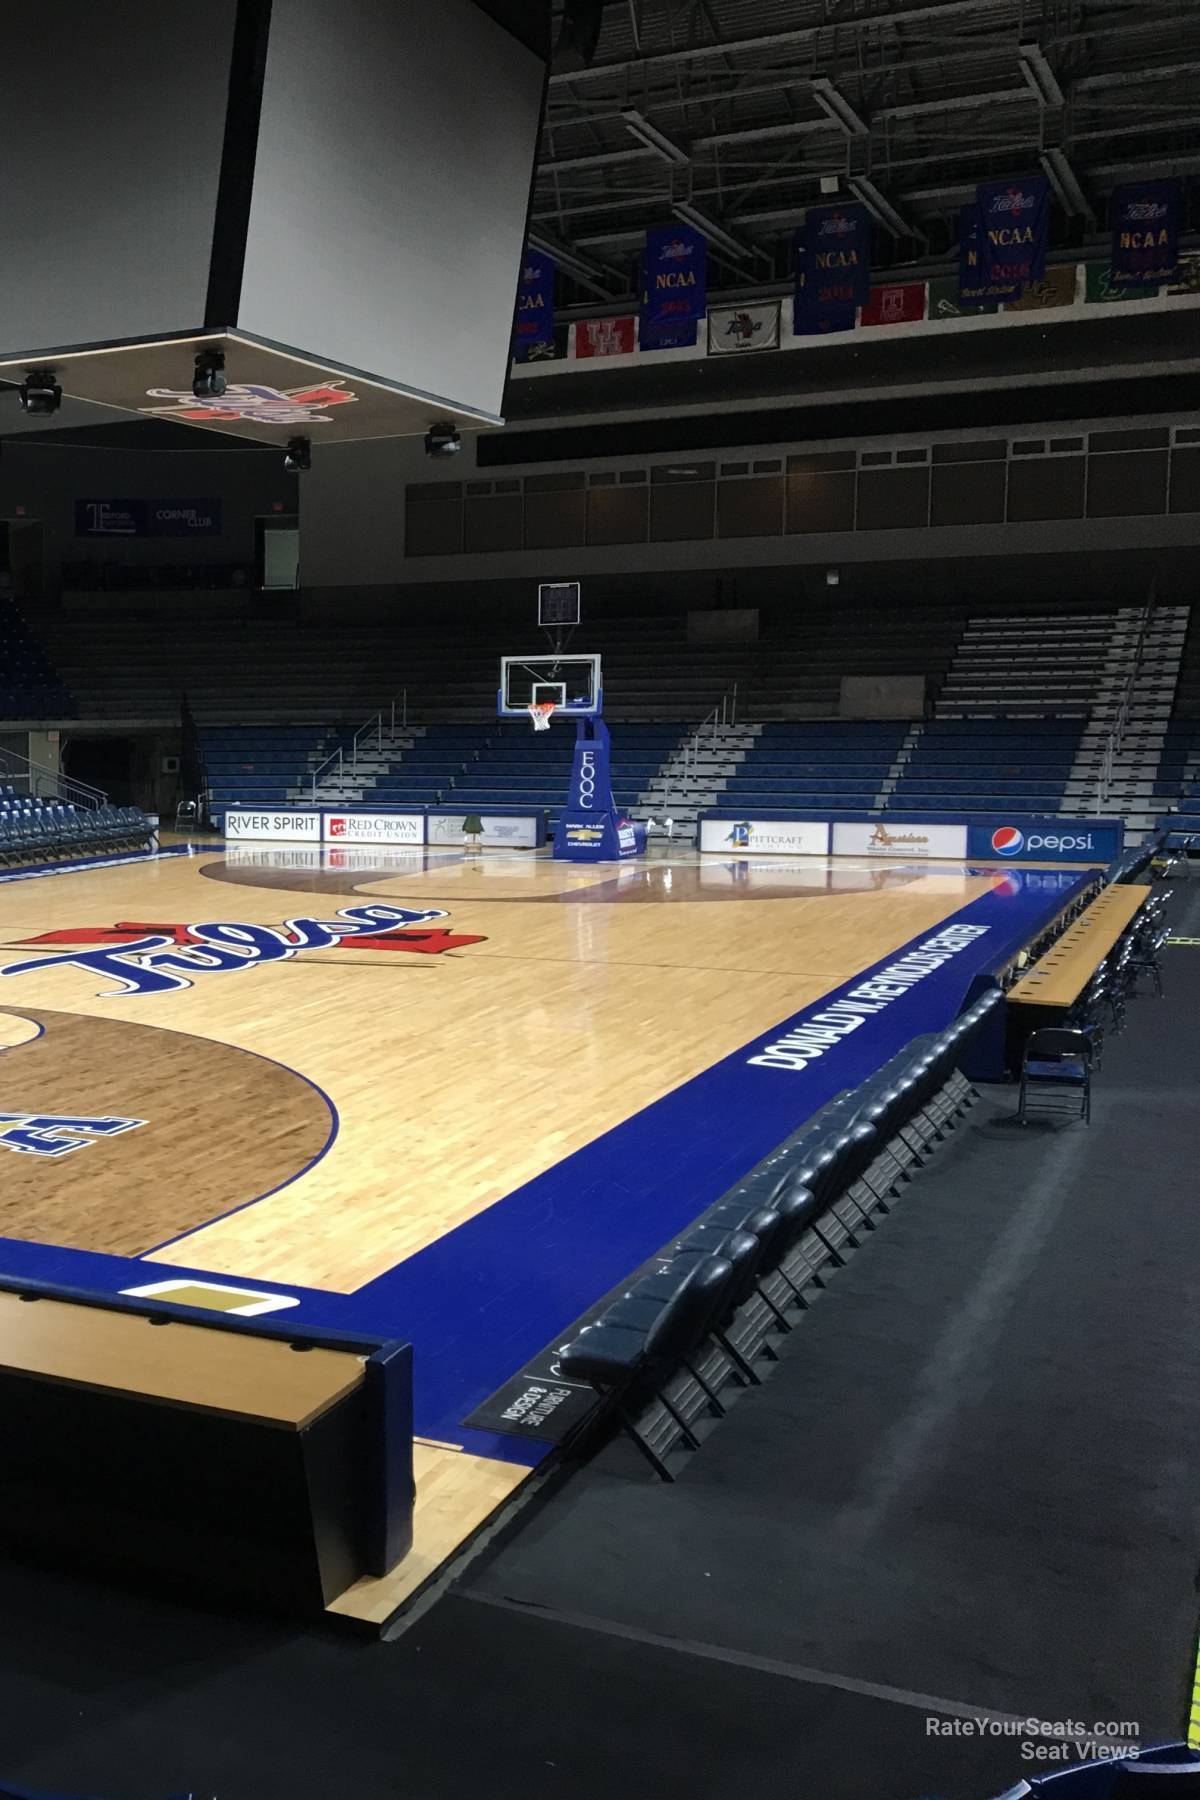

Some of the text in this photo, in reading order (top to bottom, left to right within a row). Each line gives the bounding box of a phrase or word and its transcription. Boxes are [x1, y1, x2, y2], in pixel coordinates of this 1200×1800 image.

[987, 225, 1034, 247] NCAA
[1119, 227, 1169, 249] NCAA
[815, 249, 860, 269] NCAA
[656, 271, 696, 289] NCAA
[155, 508, 198, 521] CORNER
[186, 516, 213, 528] CLUB
[228, 815, 316, 834] RIVER SPIRIT
[348, 818, 417, 831] RED CROWN
[347, 830, 417, 839] CREDIT UNION
[749, 835, 803, 844] PITTCRAFT
[1027, 833, 1092, 853] pepsi
[746, 1013, 866, 1071] DONALD
[848, 951, 953, 1001] REYNOLDS
[919, 924, 992, 953] CENTER
[500, 1392, 543, 1421] DESIGN
[519, 1387, 572, 1427] FURNITURE
